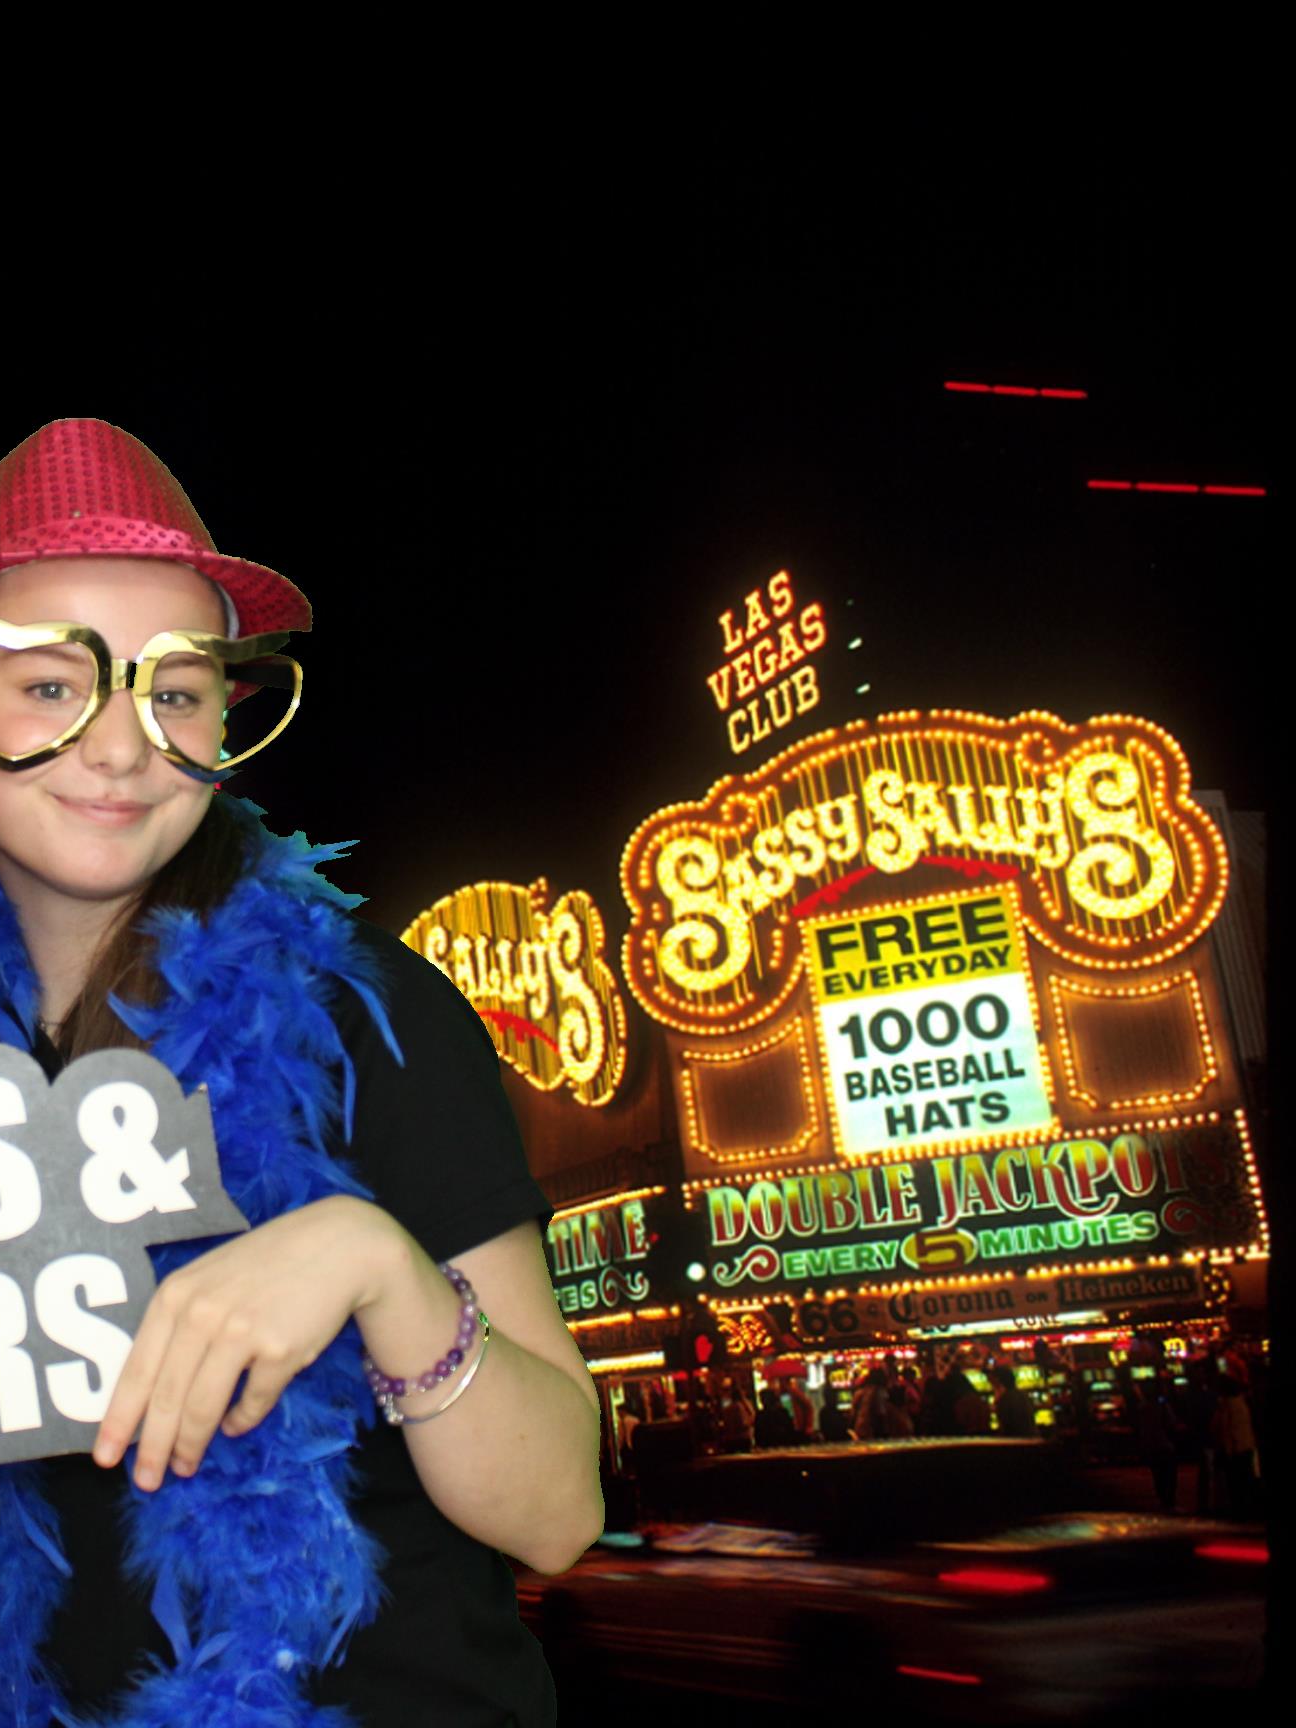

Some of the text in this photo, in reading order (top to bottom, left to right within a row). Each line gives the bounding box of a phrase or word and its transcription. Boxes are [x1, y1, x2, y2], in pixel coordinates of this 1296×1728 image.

[718, 569, 794, 654] LAS
[707, 602, 826, 711] VEGAS
[727, 664, 820, 755] CLUB
[656, 793, 861, 992] SASSY
[815, 896, 1009, 970] FREE
[823, 945, 1012, 996] EVERYDAY
[838, 993, 1010, 1059] 1000
[845, 1047, 1026, 1101] BASEBALL
[885, 1091, 1011, 1137] HATS
[77, 1081, 197, 1223] &
[705, 1162, 923, 1246] DOUBLE
[783, 1211, 1160, 1280] EVERY 5 MINUTES
[555, 1279, 599, 1313] ES
[888, 1287, 1016, 1325] Corona
[1063, 1274, 1192, 1301] Heineken
